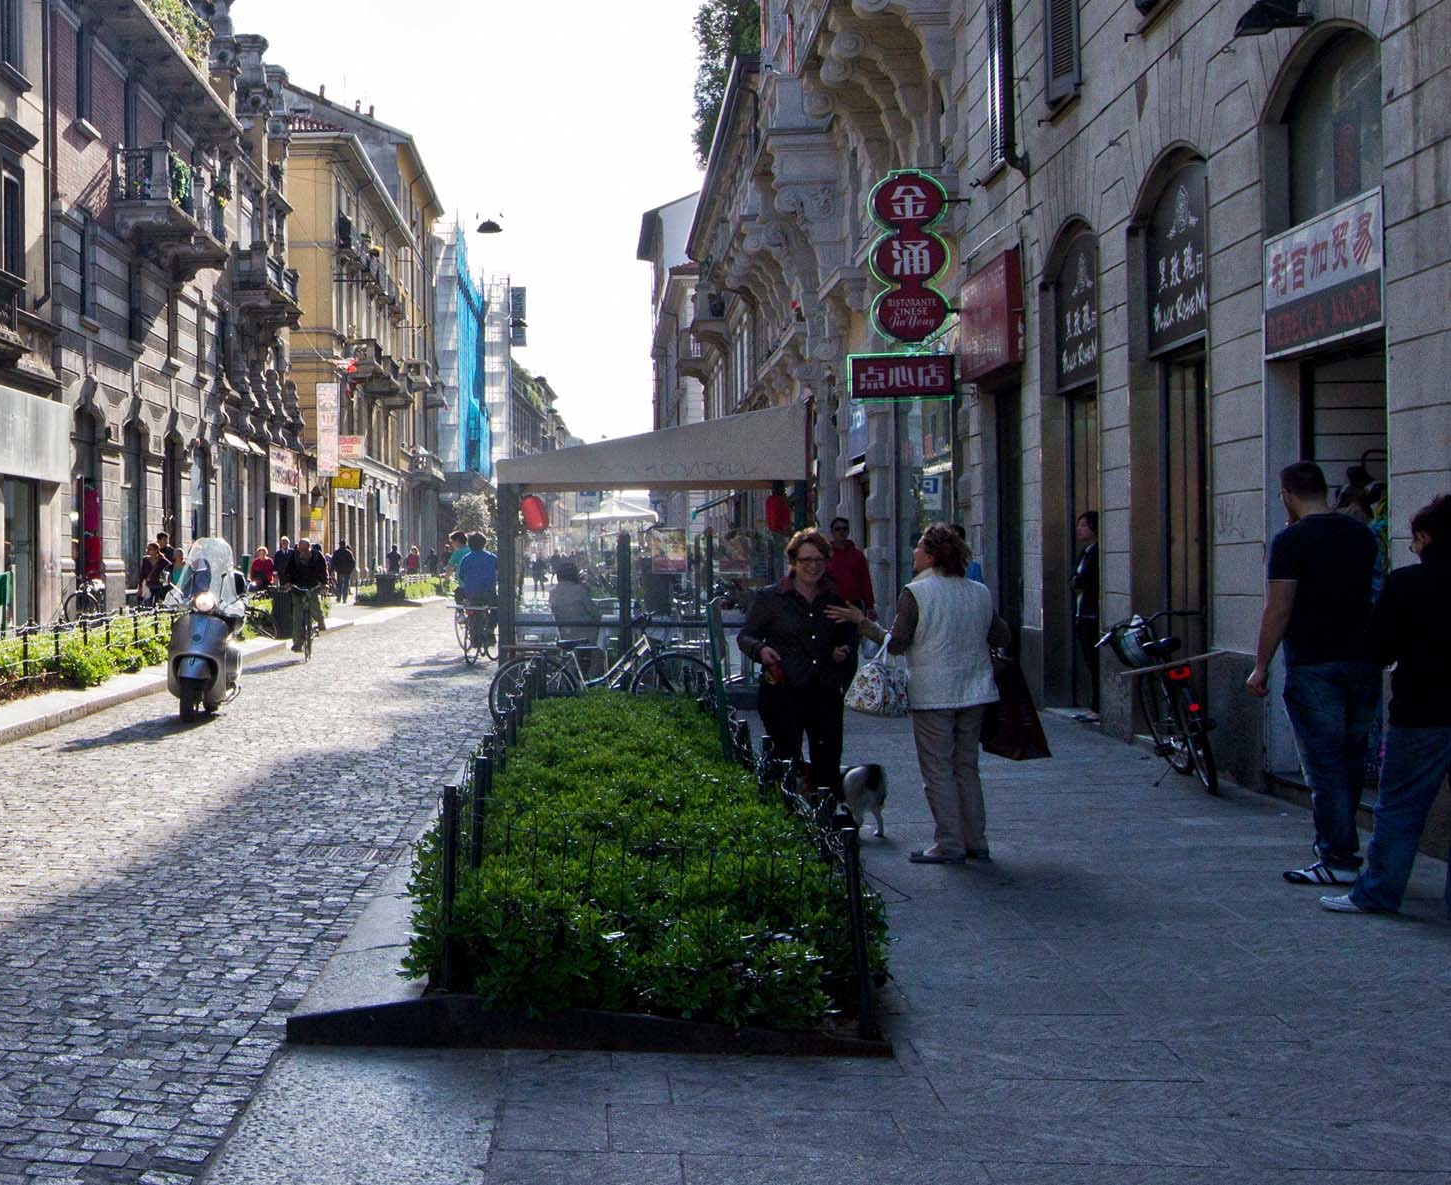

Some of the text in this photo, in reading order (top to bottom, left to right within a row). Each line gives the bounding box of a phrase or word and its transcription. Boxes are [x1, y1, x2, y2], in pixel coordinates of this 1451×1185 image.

[1272, 213, 1373, 297] 利百加贸易
[887, 297, 937, 308] RISTORANTE
[894, 307, 929, 317] CINESE
[859, 363, 946, 390] 点心店
